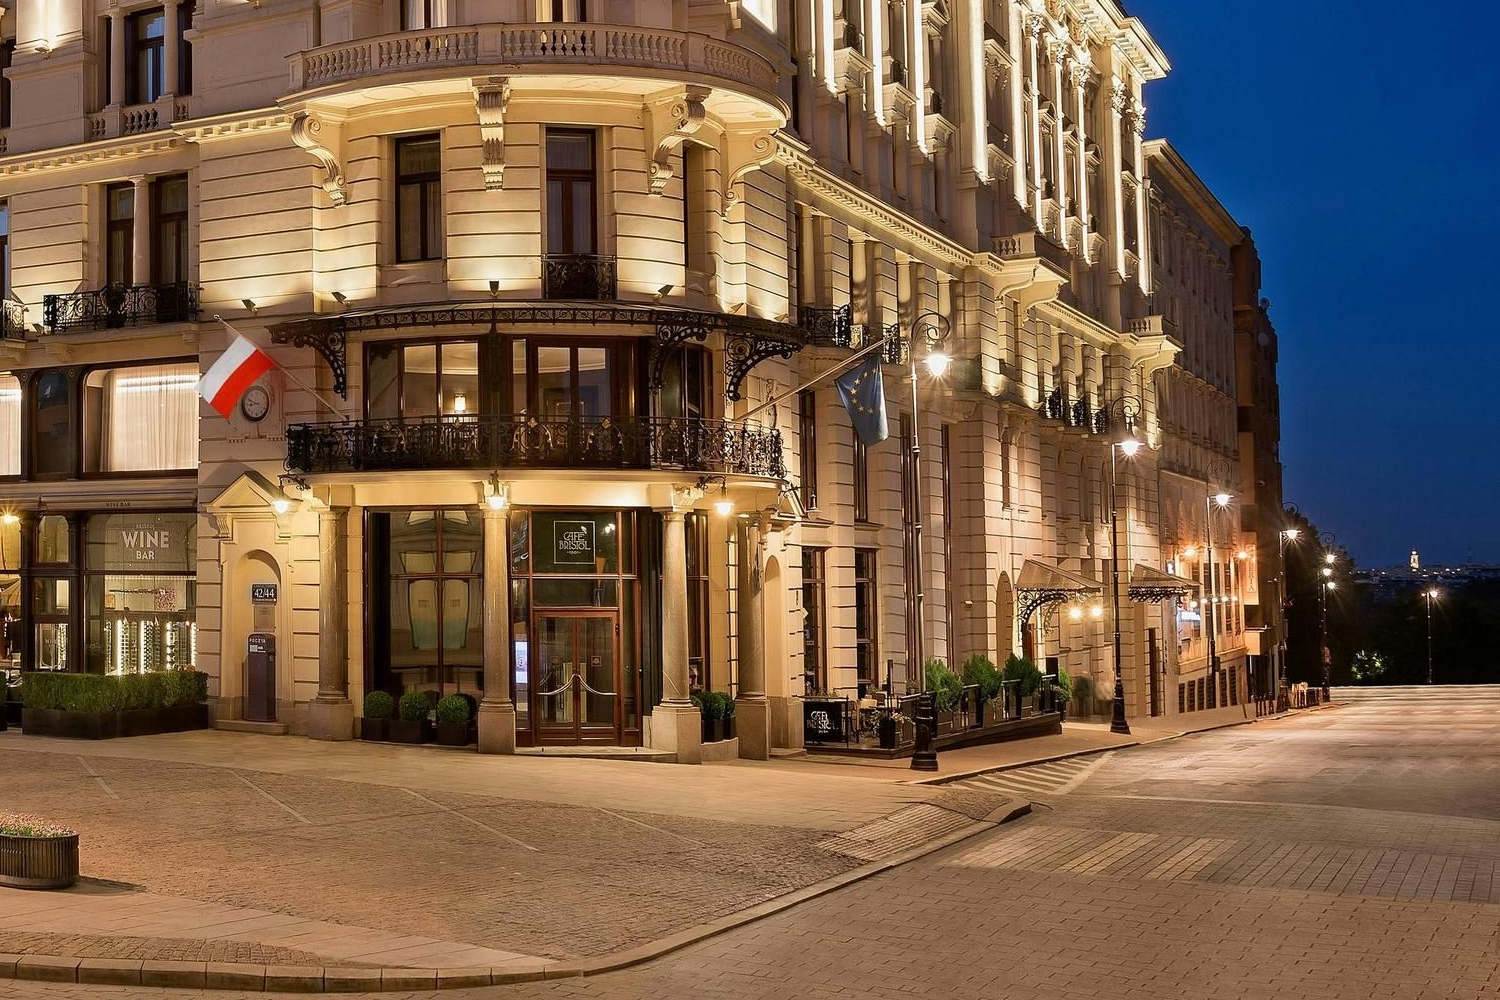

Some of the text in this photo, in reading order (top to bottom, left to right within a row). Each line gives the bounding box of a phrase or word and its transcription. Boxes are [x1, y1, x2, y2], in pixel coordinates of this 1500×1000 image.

[122, 531, 170, 548] WINE
[558, 540, 591, 550] BRISTOL
[136, 550, 155, 560] BAR
[254, 588, 275, 598] 42/44
